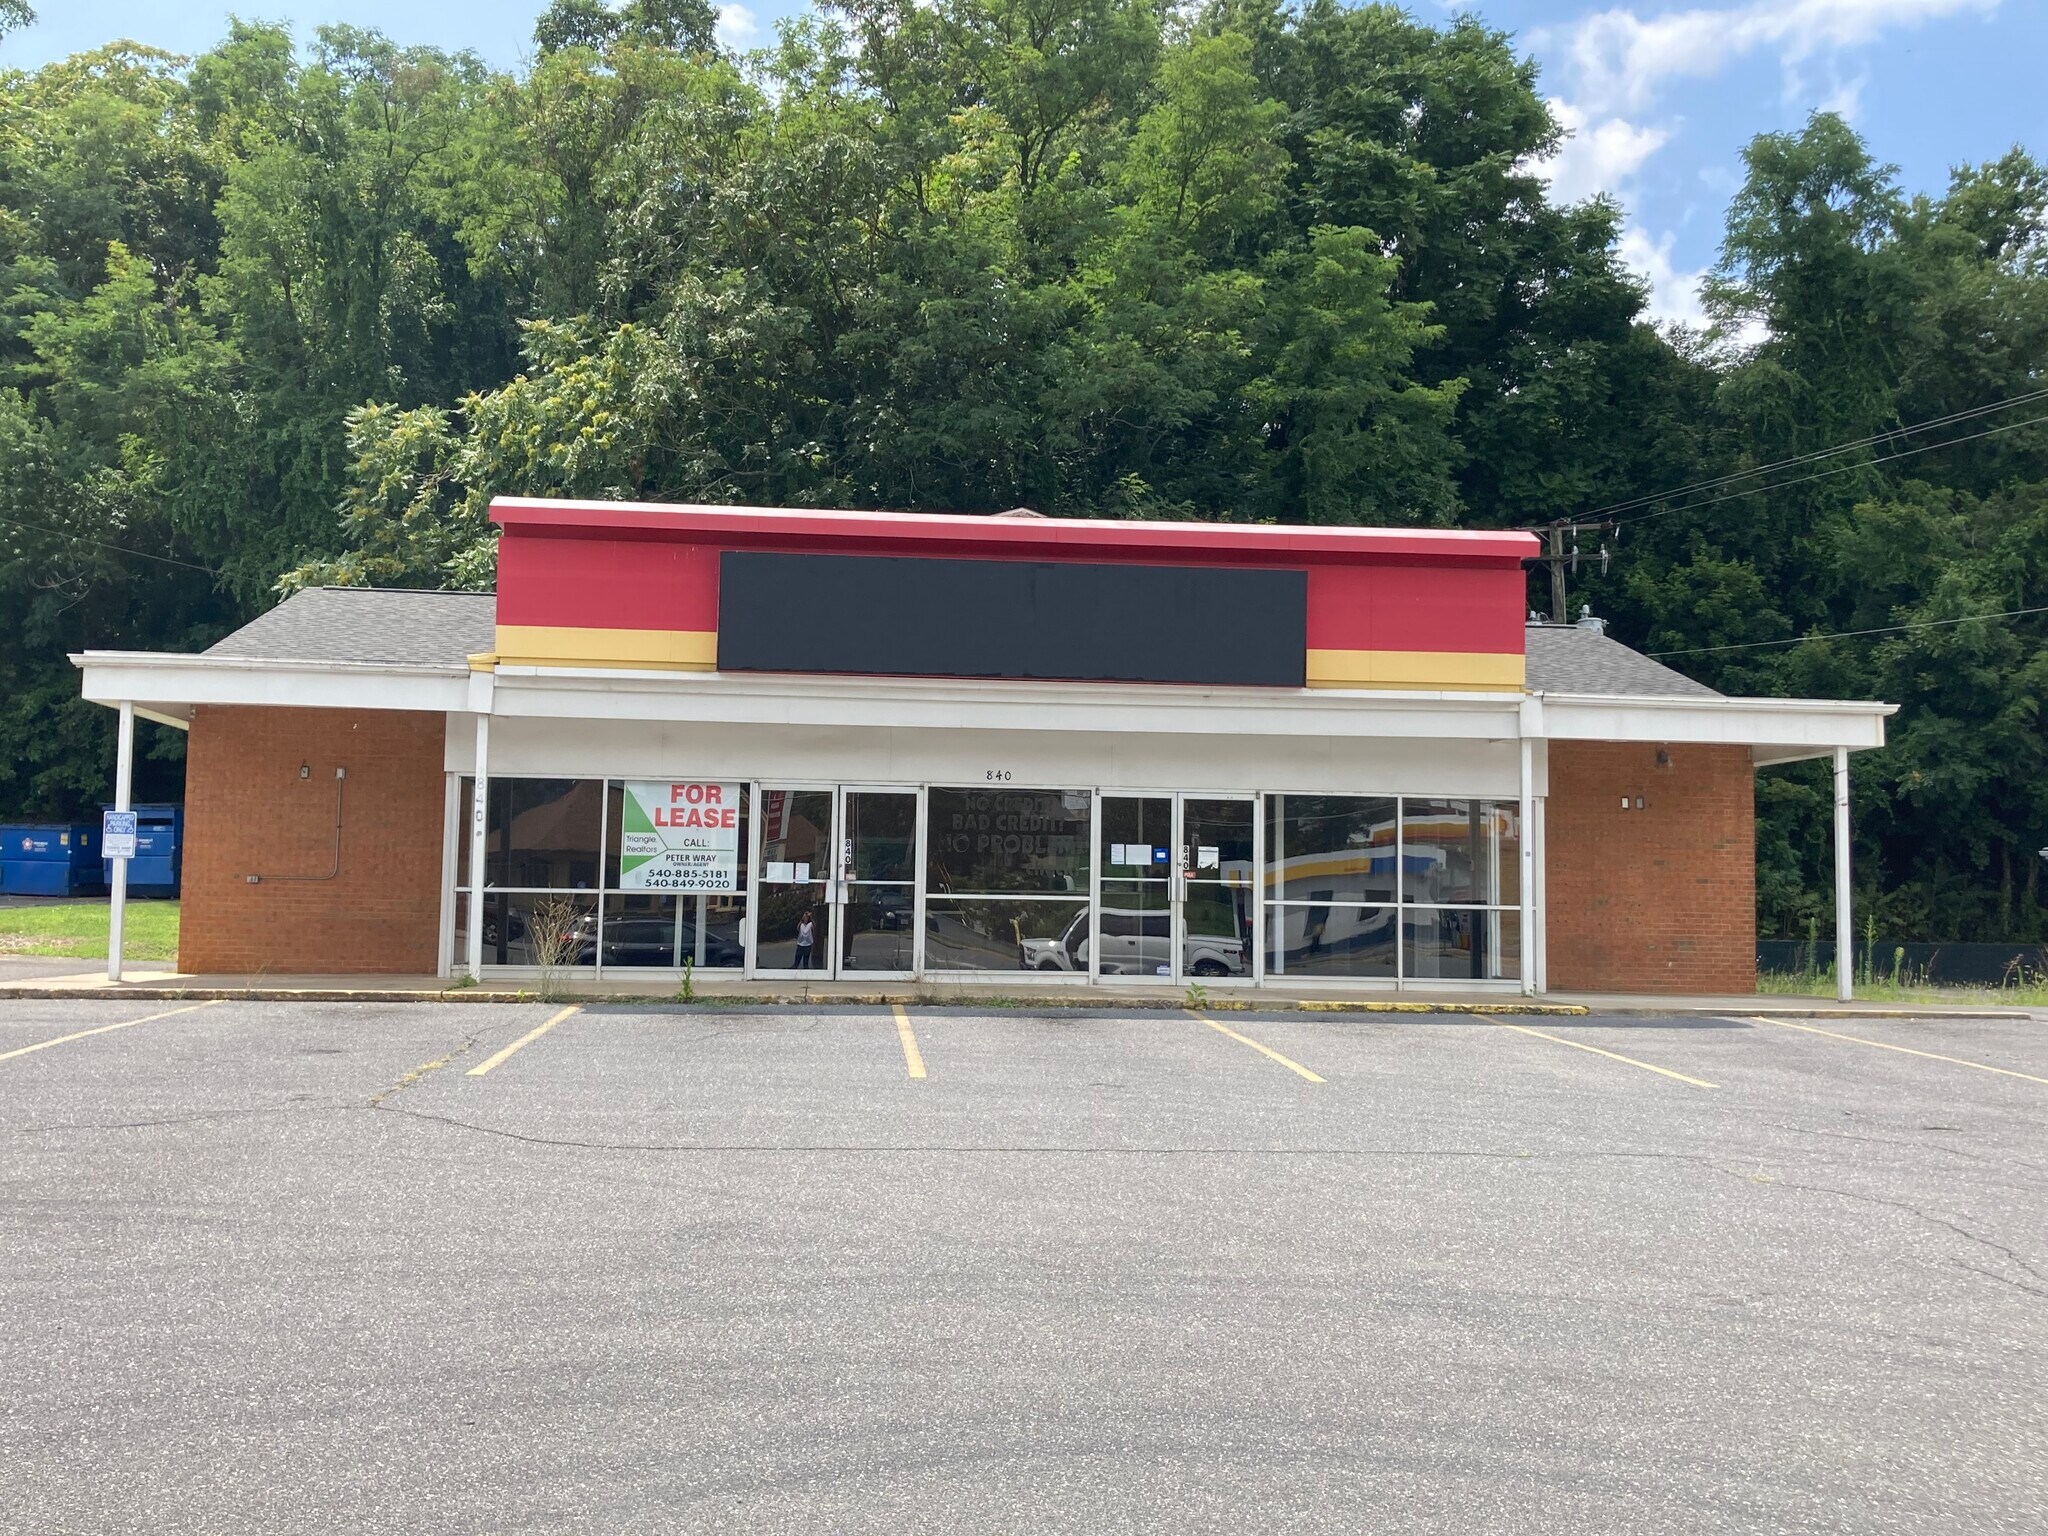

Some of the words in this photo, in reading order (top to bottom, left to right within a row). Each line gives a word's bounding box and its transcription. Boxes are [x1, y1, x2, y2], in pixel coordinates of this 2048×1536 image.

[986, 770, 1012, 781] 840
[670, 784, 722, 804] FOR
[654, 807, 736, 828] LEASE
[952, 813, 990, 831] BAD
[626, 835, 656, 845] Triangle
[683, 838, 710, 847] CALL:
[626, 845, 658, 853] Realtors
[665, 854, 690, 862] PETER
[648, 869, 728, 879] 540-885-5181
[645, 879, 730, 889] 540-849-9020
